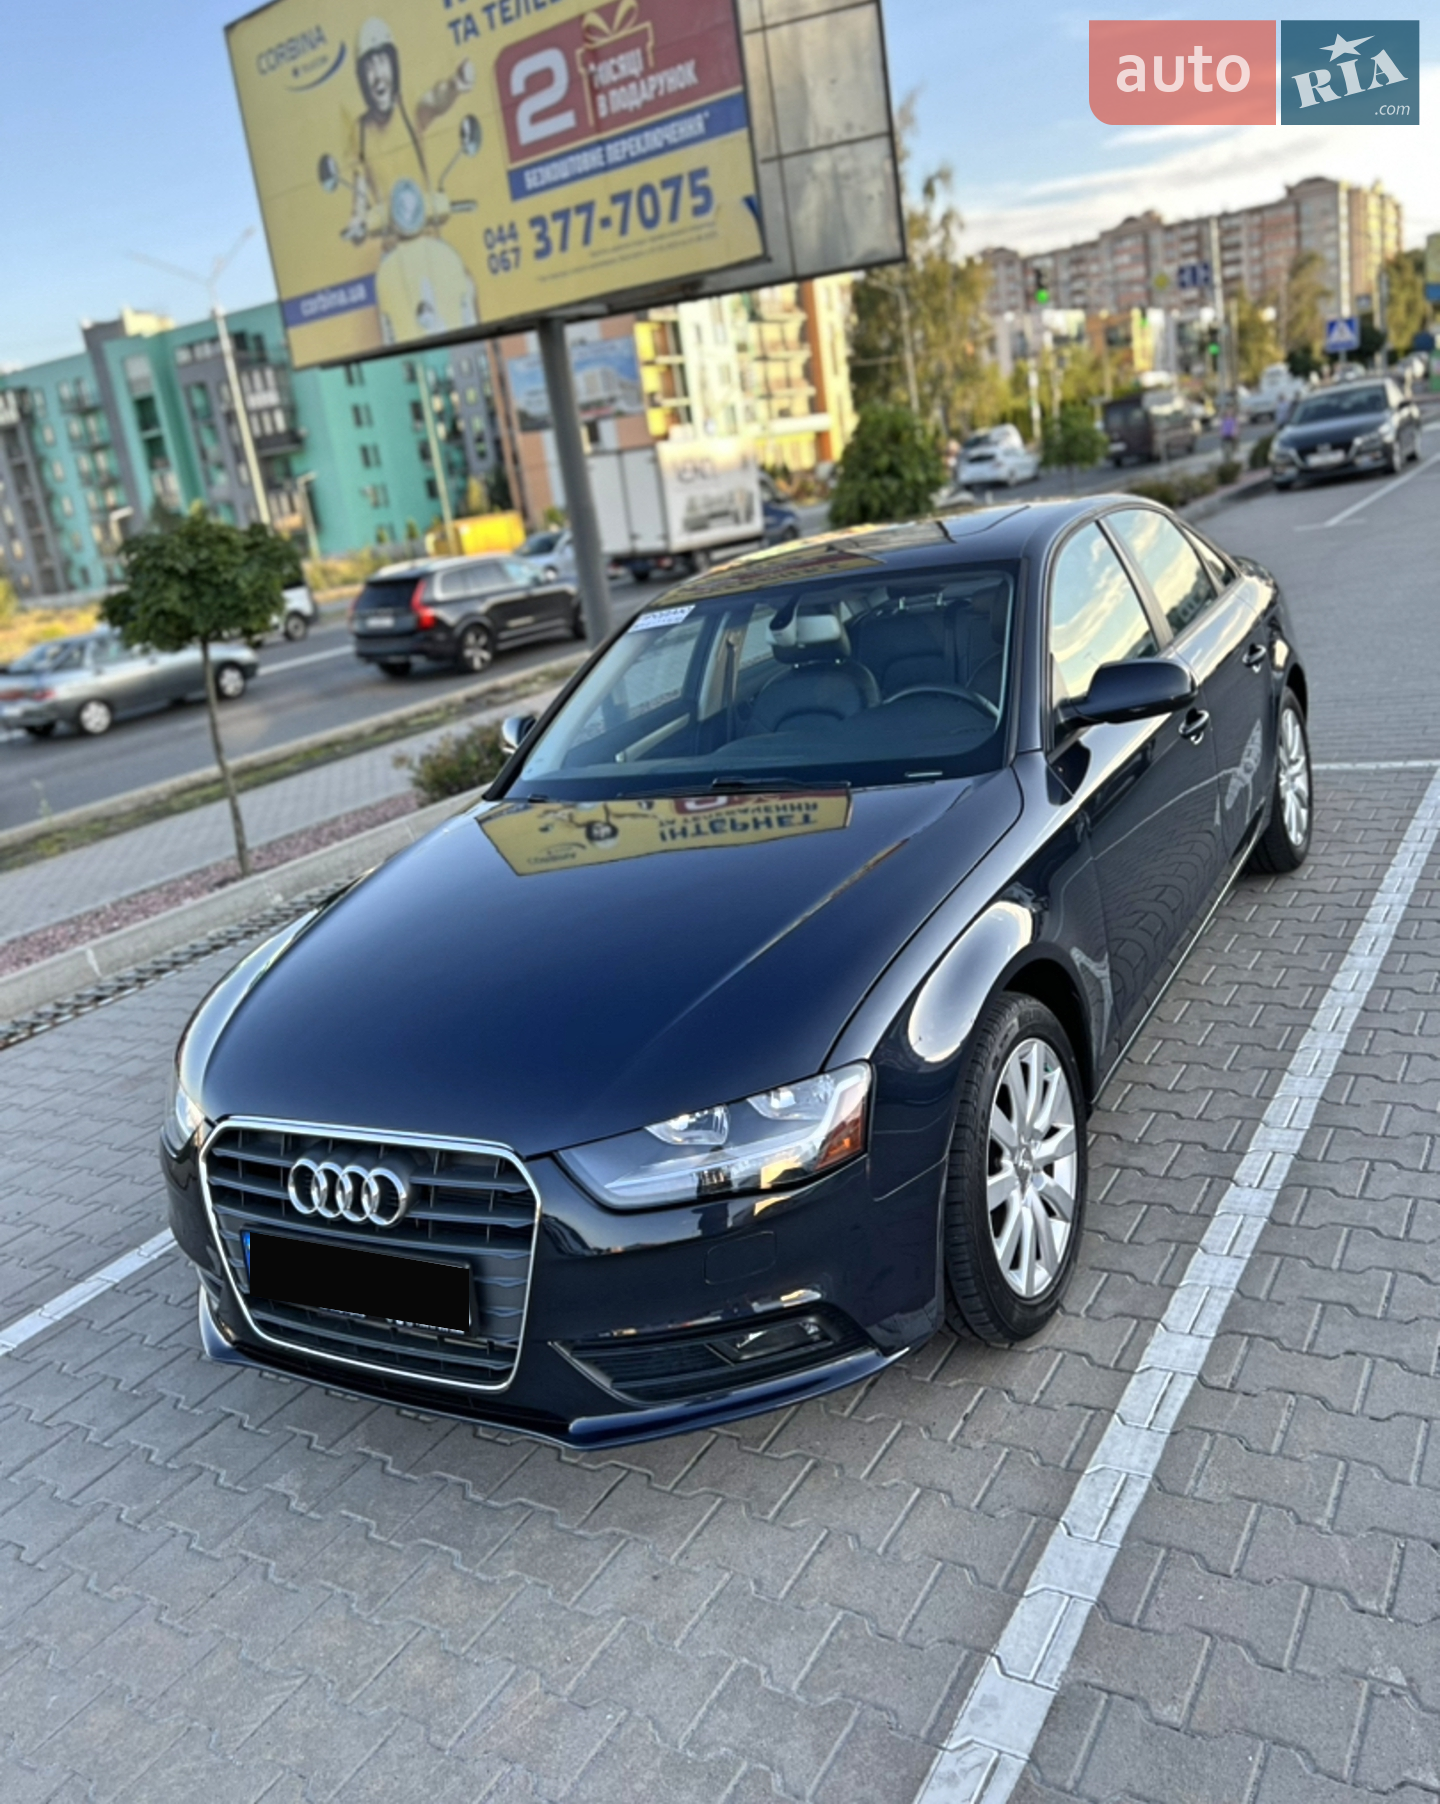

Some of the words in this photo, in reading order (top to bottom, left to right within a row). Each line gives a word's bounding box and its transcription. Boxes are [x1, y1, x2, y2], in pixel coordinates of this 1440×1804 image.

[448, 13, 480, 46] ТА
[510, 47, 577, 146] 2
[608, 59, 699, 115] ПОДАРУНОК
[484, 220, 519, 251] 044
[528, 166, 715, 262] 377-7075
[487, 246, 521, 276] 067
